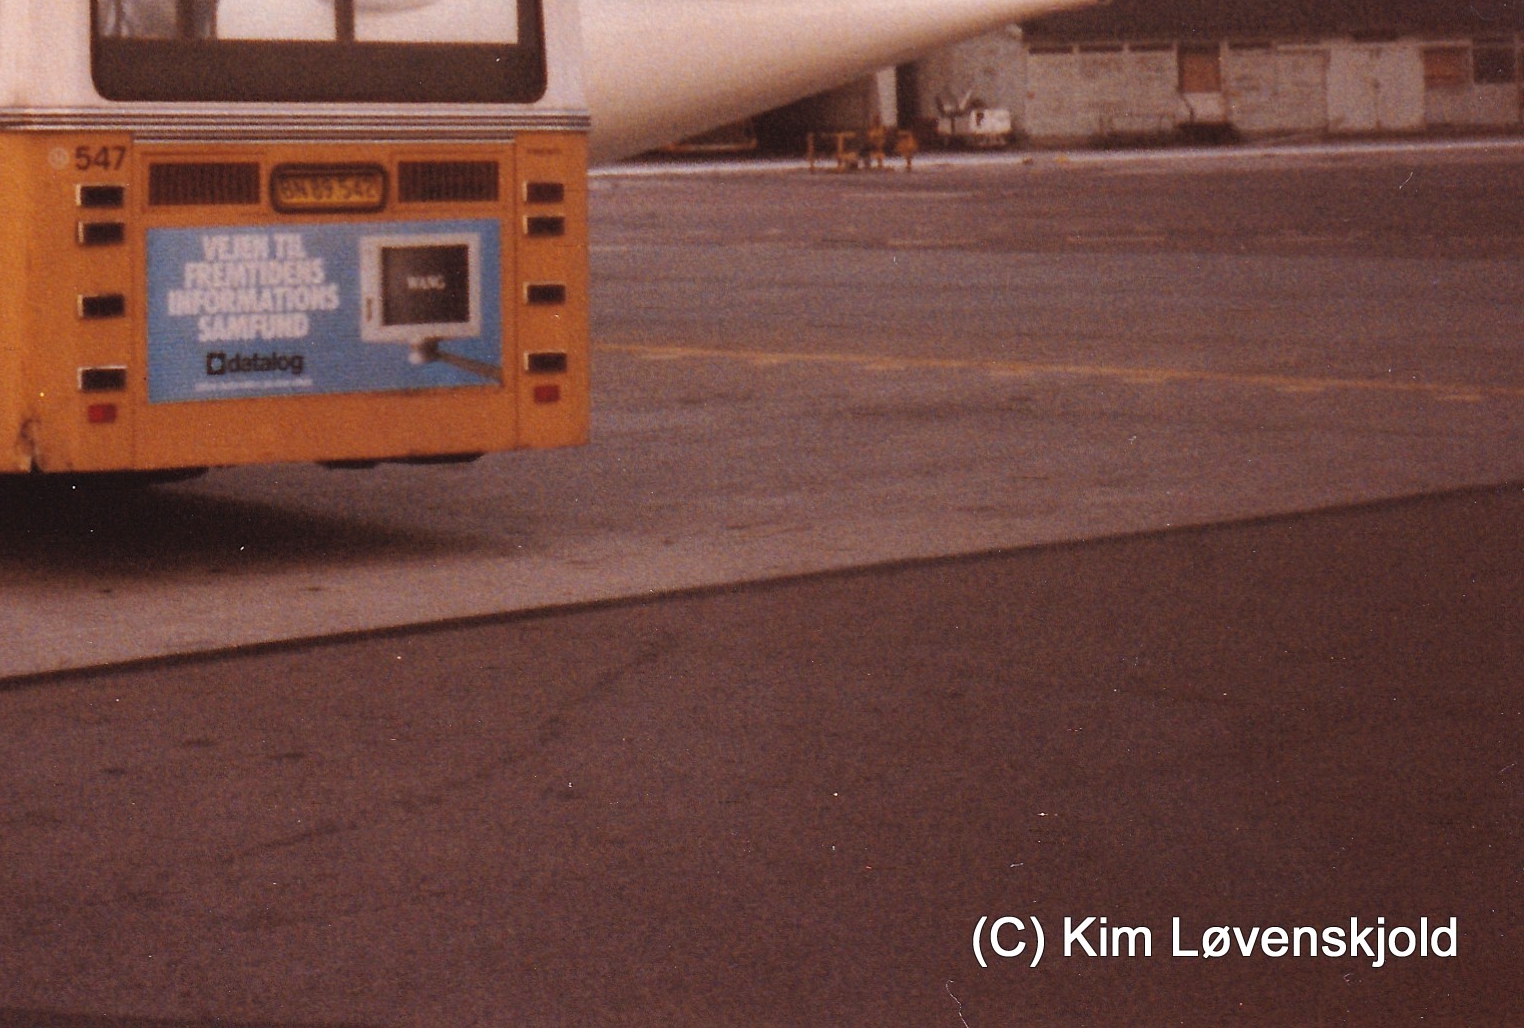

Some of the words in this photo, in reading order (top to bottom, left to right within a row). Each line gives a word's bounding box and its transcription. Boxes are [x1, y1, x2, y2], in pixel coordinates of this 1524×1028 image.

[76, 146, 126, 170] 547
[203, 235, 269, 261] VEJEN
[274, 233, 307, 258] TIL
[184, 257, 325, 288] FREMTIDENS
[167, 283, 340, 316] INFORMATIONS
[197, 312, 309, 342] SAMFUND
[227, 352, 304, 375] datalog
